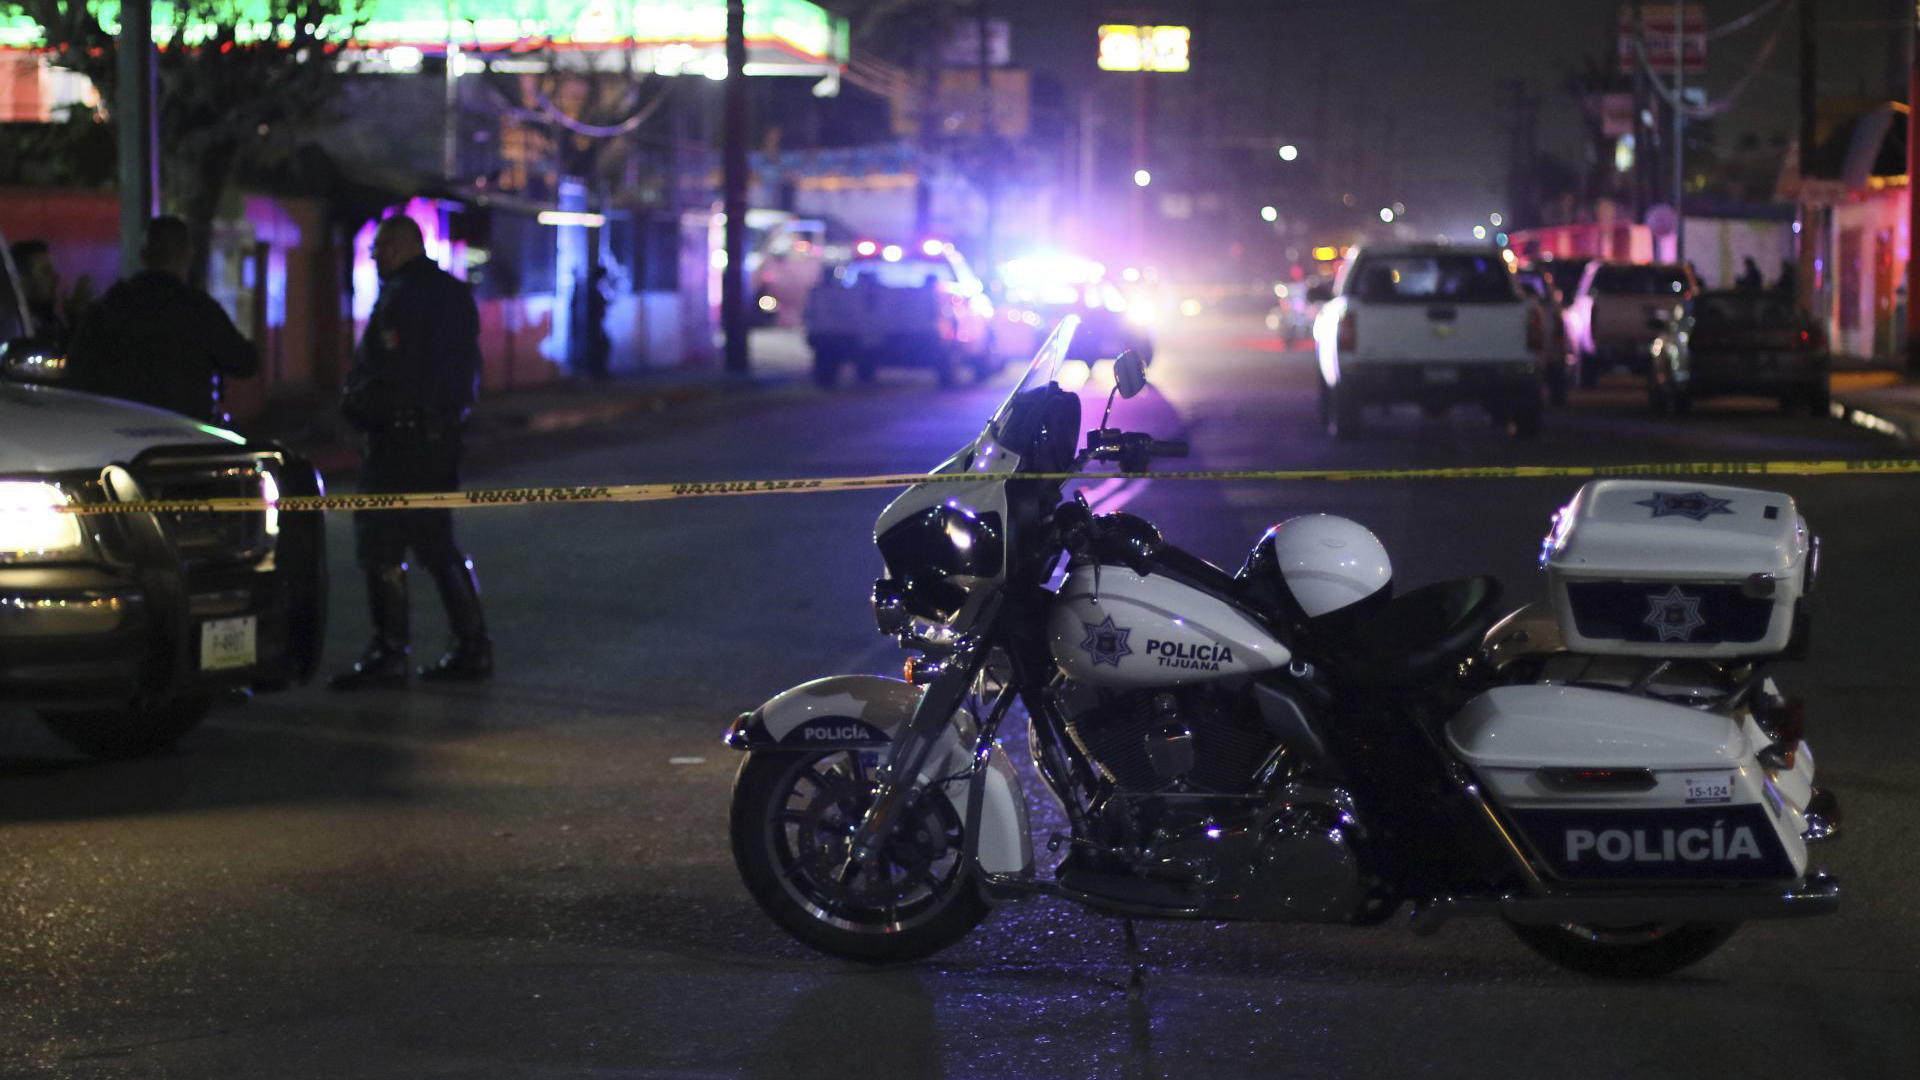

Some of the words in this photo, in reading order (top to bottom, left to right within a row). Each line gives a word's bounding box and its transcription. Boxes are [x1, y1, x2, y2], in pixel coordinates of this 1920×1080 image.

[1146, 641, 1232, 662] POLICÍA
[1158, 657, 1219, 671] TIJUANA
[805, 724, 869, 739] POLICÍA
[1688, 786, 1728, 797] 15-124
[1565, 819, 1762, 862] POLICÍA
